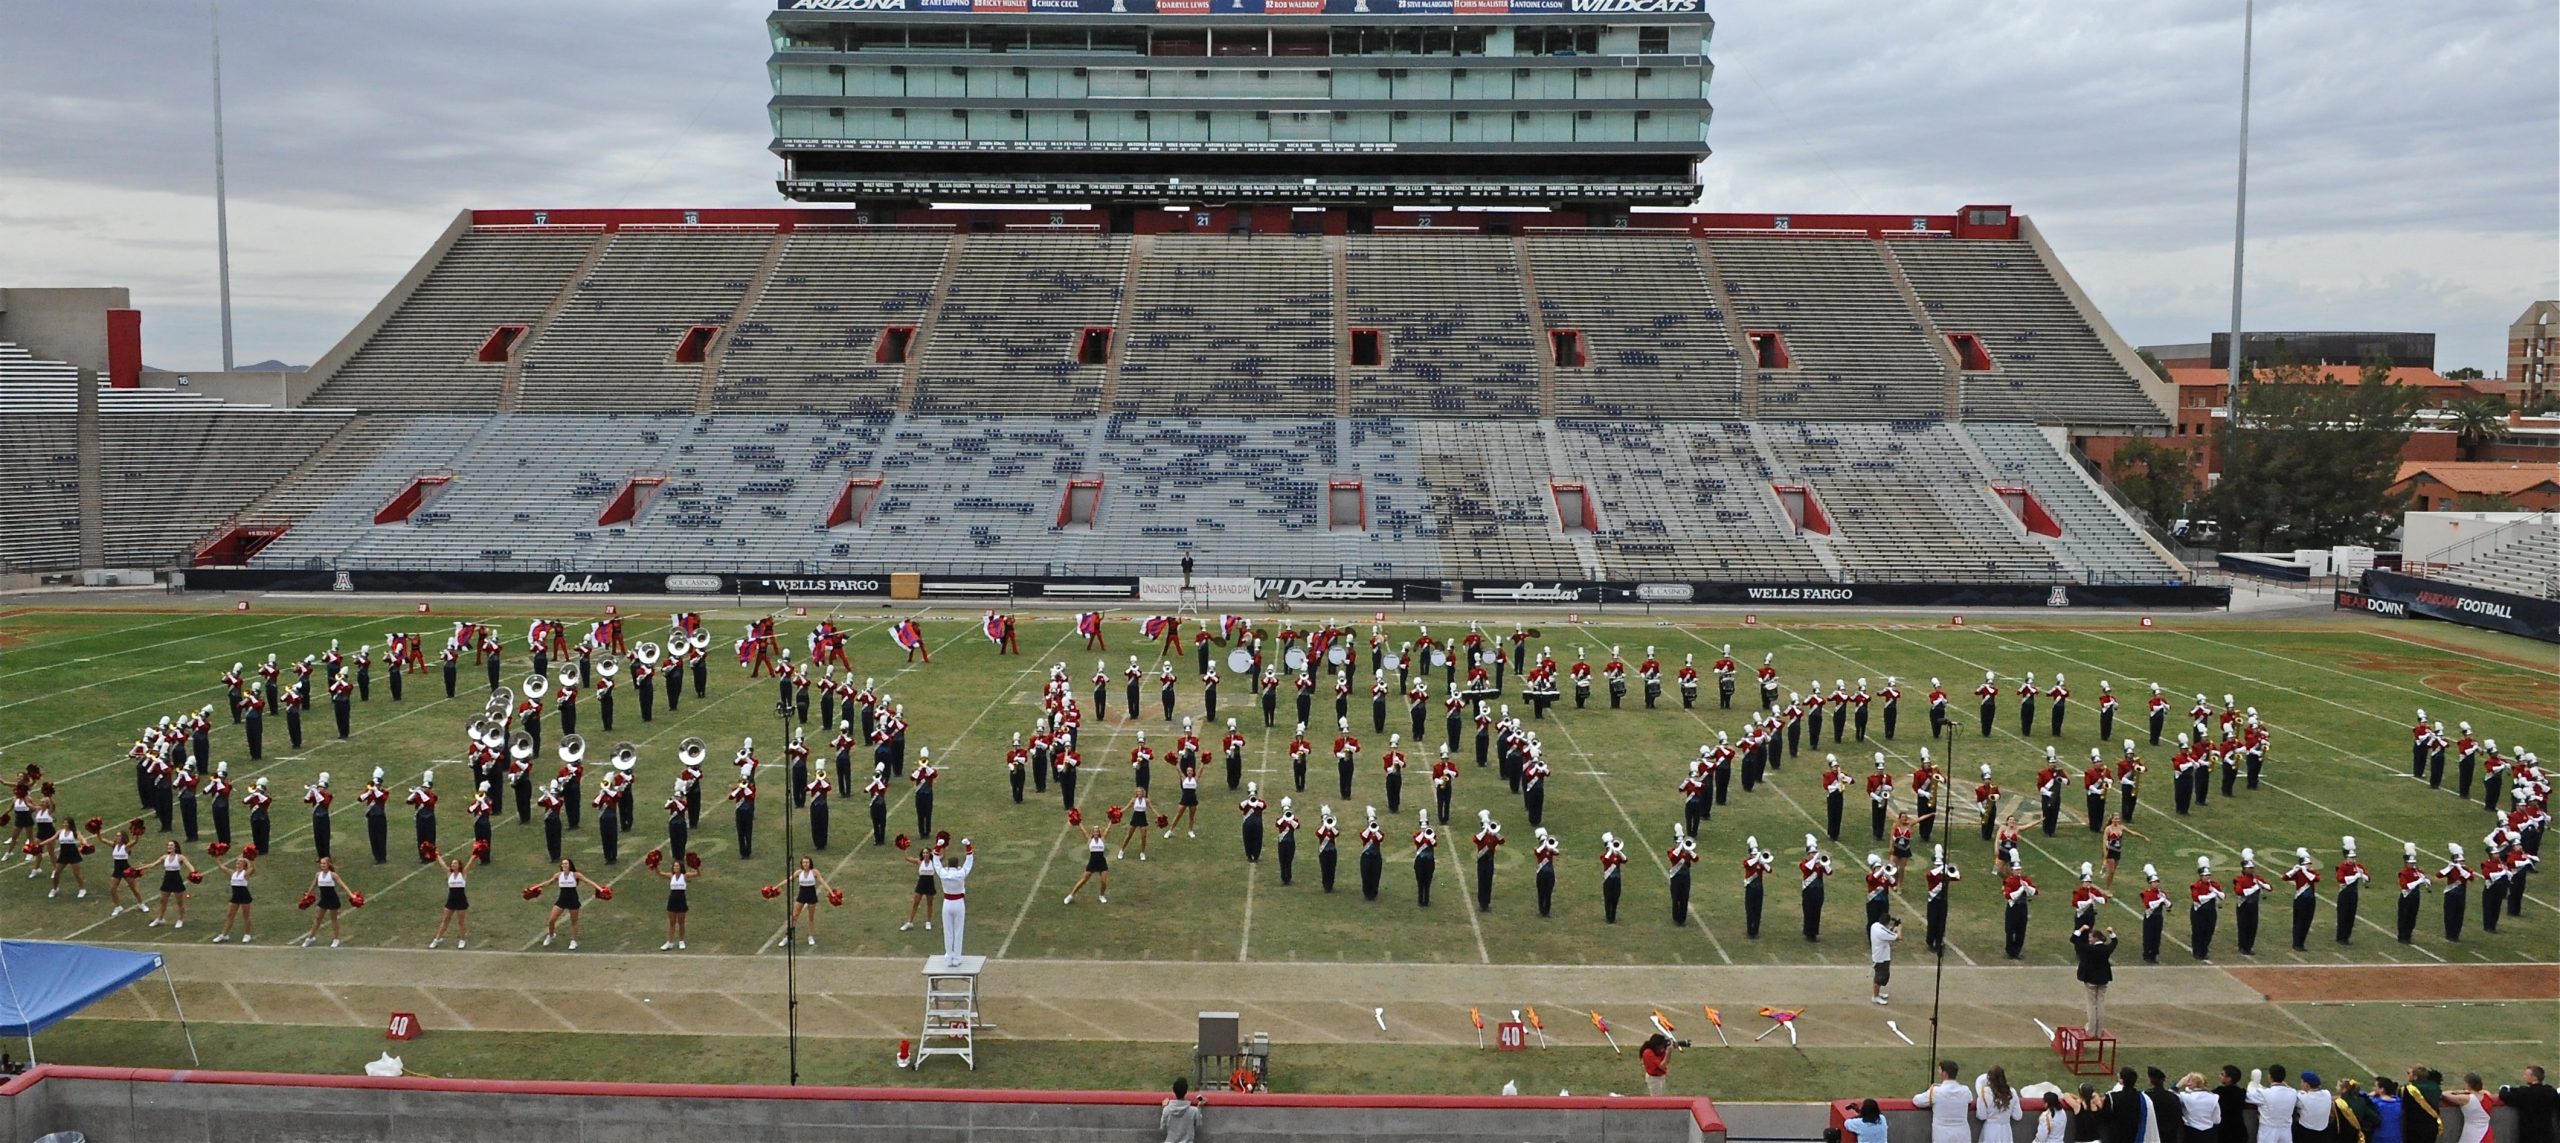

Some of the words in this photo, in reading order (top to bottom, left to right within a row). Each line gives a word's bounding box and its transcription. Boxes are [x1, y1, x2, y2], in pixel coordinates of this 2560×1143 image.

[791, 0, 906, 10] ARIZONA
[1037, 0, 1060, 8] CHUCK
[1061, 0, 1079, 8] CECIL
[1515, 1, 1541, 9] ANTOINE
[1541, 1, 1563, 9] CASON
[1571, 0, 1698, 12] WILDCATS
[536, 216, 546, 224] 17
[685, 216, 698, 224] 18
[857, 216, 869, 224] 19
[1050, 216, 1064, 225] 20
[1197, 216, 1209, 226] 21
[1418, 218, 1432, 226] 22
[1615, 219, 1628, 228] 23
[1776, 221, 1788, 230] 24
[1912, 222, 1926, 230] 25
[178, 376, 189, 386] 16
[547, 574, 612, 593] Bashas'
[774, 580, 827, 591] WELLS
[829, 580, 879, 591] FARGO
[1142, 584, 1177, 594] UNIVERSITY
[1218, 584, 1236, 594] BAND
[1238, 584, 1250, 594] DAY
[1747, 588, 1800, 600] WELLS
[1802, 588, 1853, 600] FARGO
[2367, 598, 2404, 616] DOWN
[2455, 598, 2513, 619] FOOTBALL
[390, 1016, 408, 1036] 40
[1501, 1027, 1520, 1046] 40
